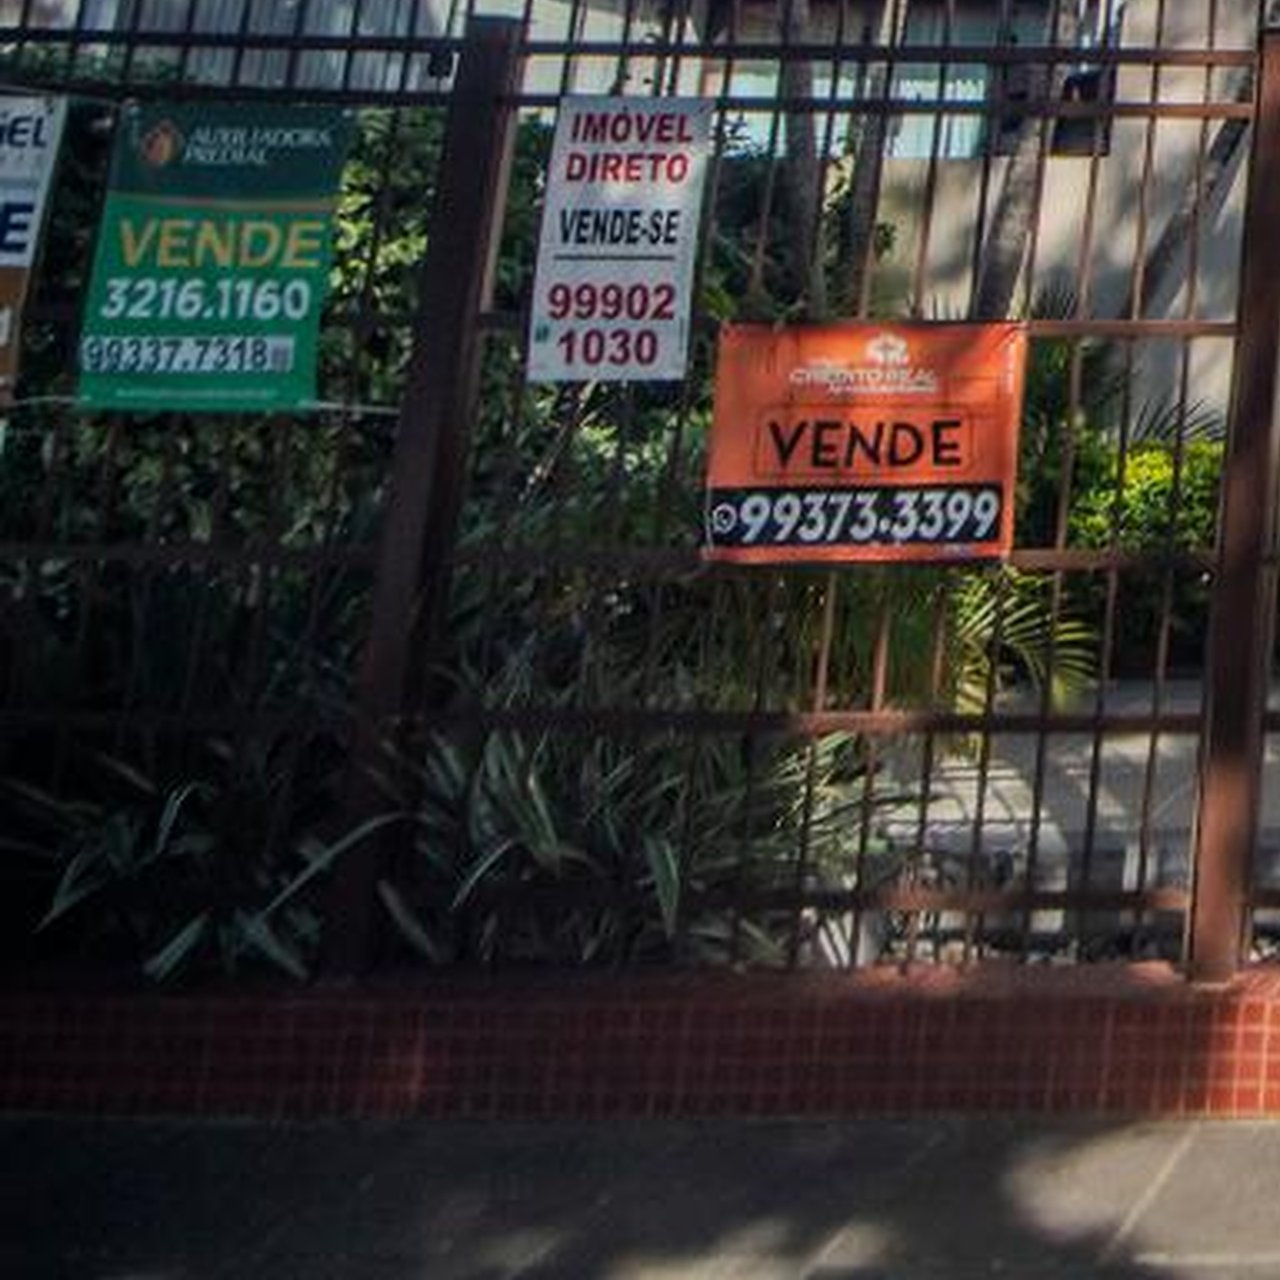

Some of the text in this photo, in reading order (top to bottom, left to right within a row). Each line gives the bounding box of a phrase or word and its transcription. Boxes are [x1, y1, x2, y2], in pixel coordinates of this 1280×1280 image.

[571, 106, 693, 143] IMÓVEL
[565, 153, 689, 182] DIRETO
[119, 218, 326, 268] VENDE
[560, 209, 680, 245] VENDE-SE
[101, 277, 310, 319] 3216.1160
[548, 283, 675, 320] 99902
[85, 336, 268, 370] 99337.7318
[557, 329, 658, 365] 1030
[768, 420, 963, 467] VENDE
[739, 489, 1000, 543] 99373.3399
